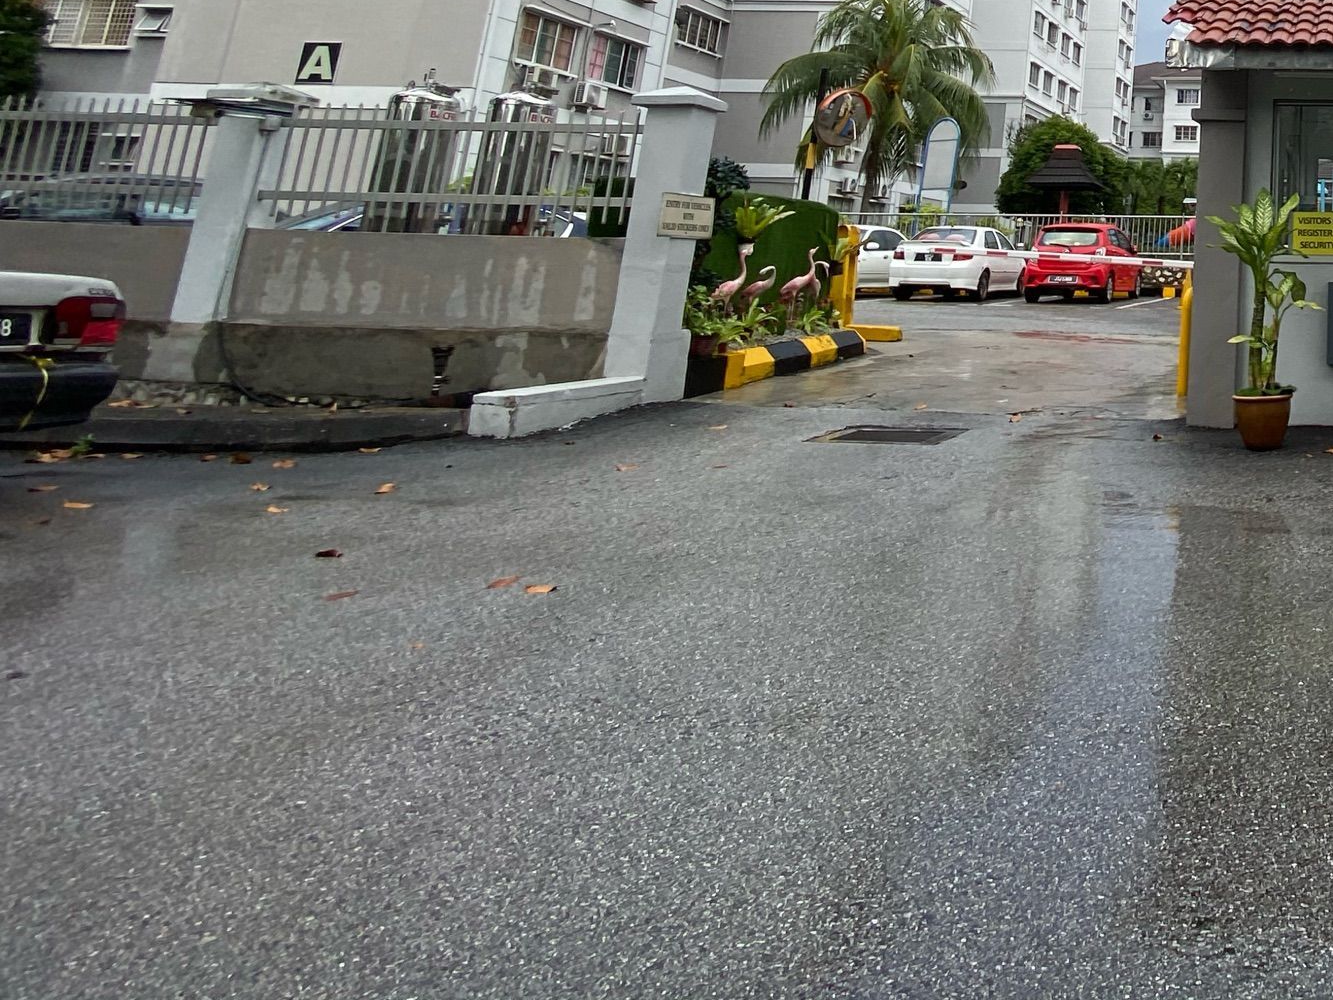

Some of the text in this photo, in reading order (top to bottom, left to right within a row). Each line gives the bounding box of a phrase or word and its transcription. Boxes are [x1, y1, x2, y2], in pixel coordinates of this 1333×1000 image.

[298, 45, 333, 80] A
[1298, 216, 1332, 225] VISITORS
[1297, 229, 1332, 237] REGISTER
